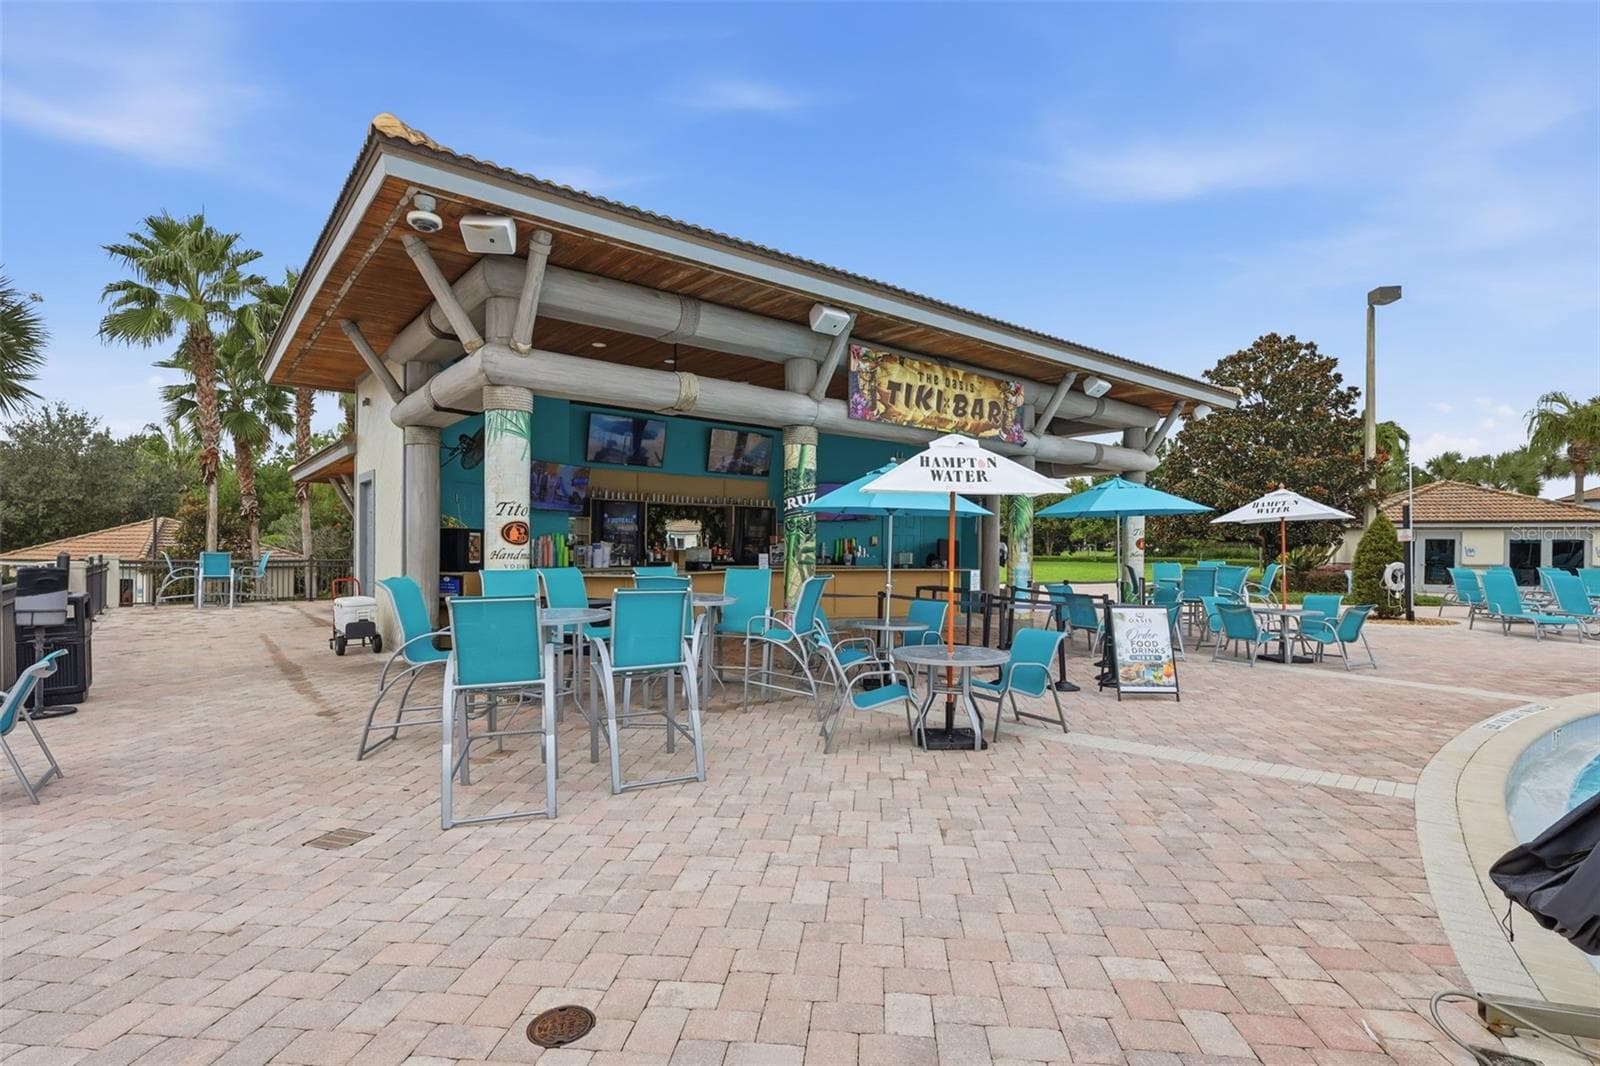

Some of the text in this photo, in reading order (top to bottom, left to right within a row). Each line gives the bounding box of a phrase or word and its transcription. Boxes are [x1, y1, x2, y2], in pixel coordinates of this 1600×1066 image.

[887, 380, 1001, 425] TIKI BAR
[930, 469, 989, 482] WATER
[784, 493, 816, 511] RUZ
[1126, 628, 1158, 640] Order
[1130, 640, 1159, 648] FOOD
[1131, 647, 1166, 655] DRINKS
